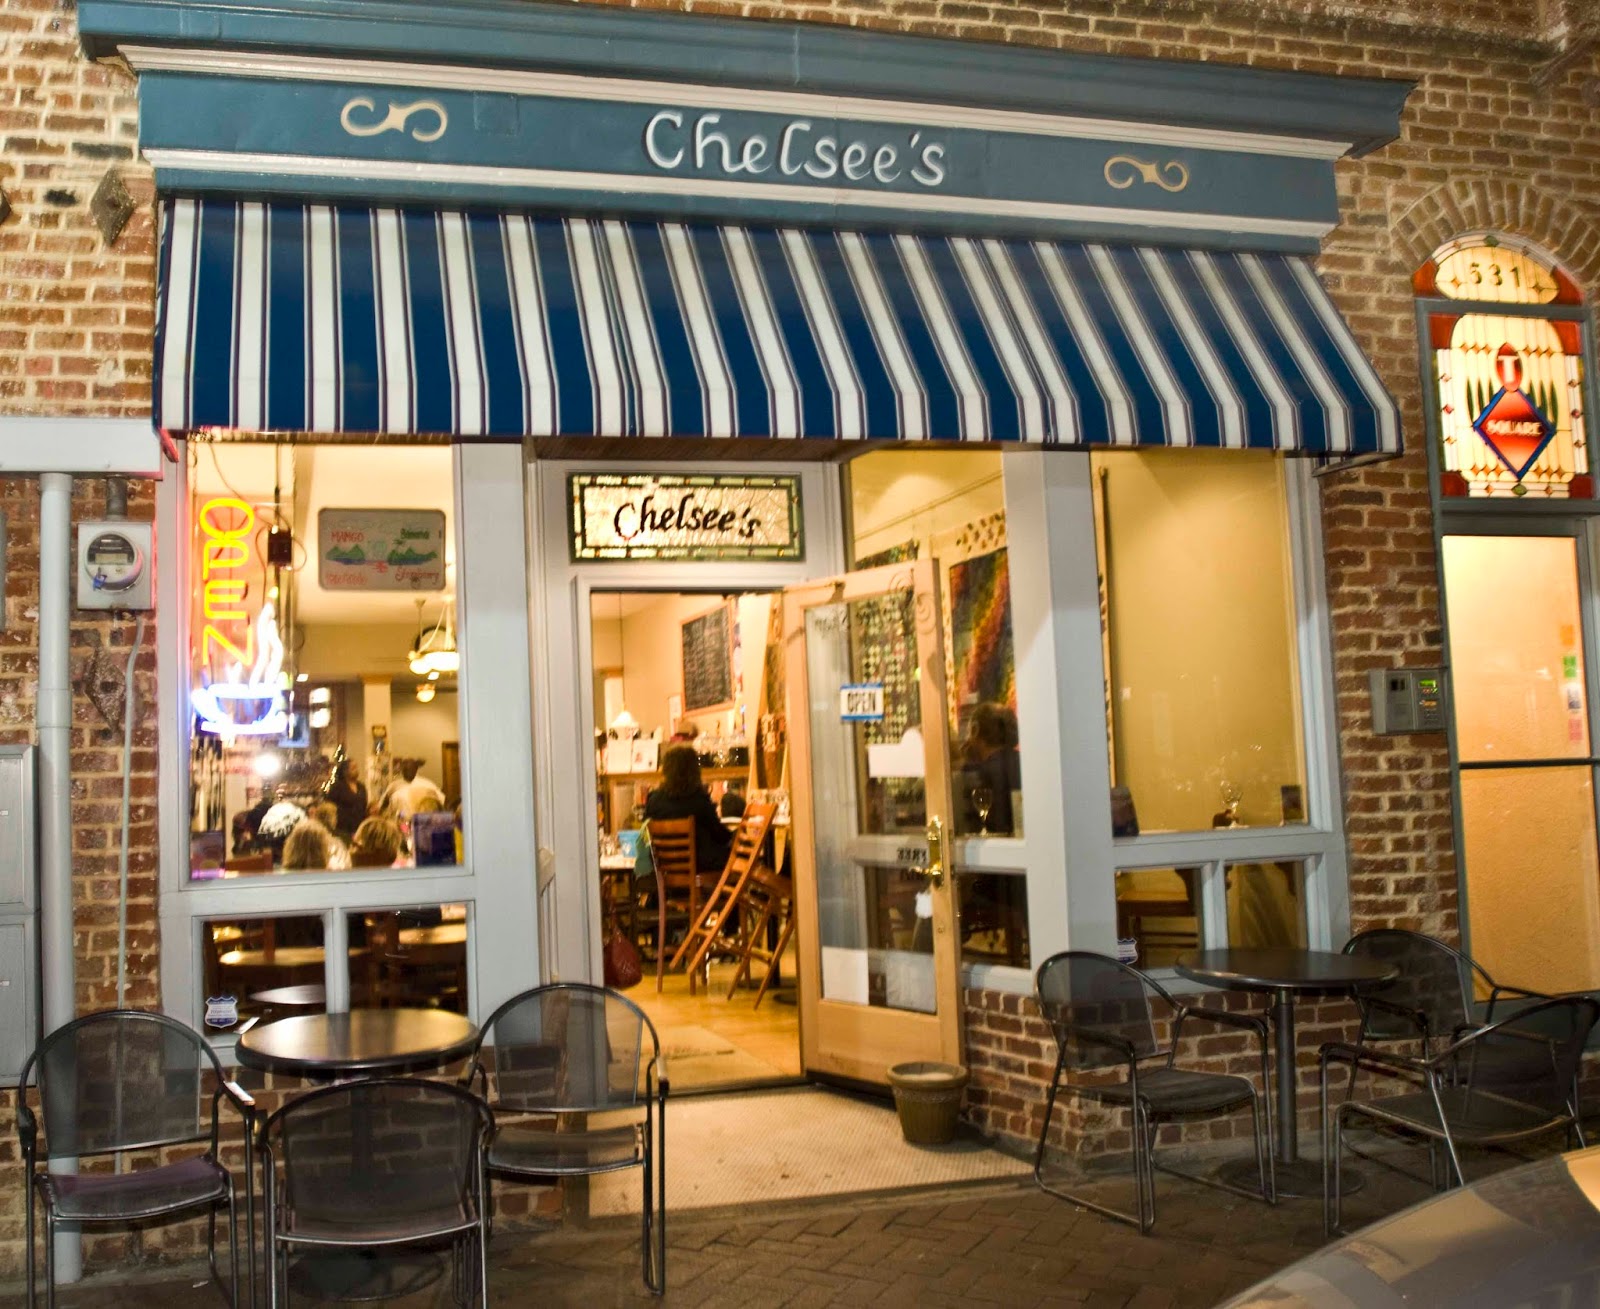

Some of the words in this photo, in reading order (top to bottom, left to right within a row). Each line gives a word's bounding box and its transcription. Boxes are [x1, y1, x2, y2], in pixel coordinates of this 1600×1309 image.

[643, 110, 947, 187] Chelsee's
[1470, 262, 1520, 287] 531
[1486, 419, 1542, 436] SQUARE
[613, 493, 762, 541] Chelsee's
[200, 497, 254, 666] OPEN
[847, 692, 876, 712] OPEN
